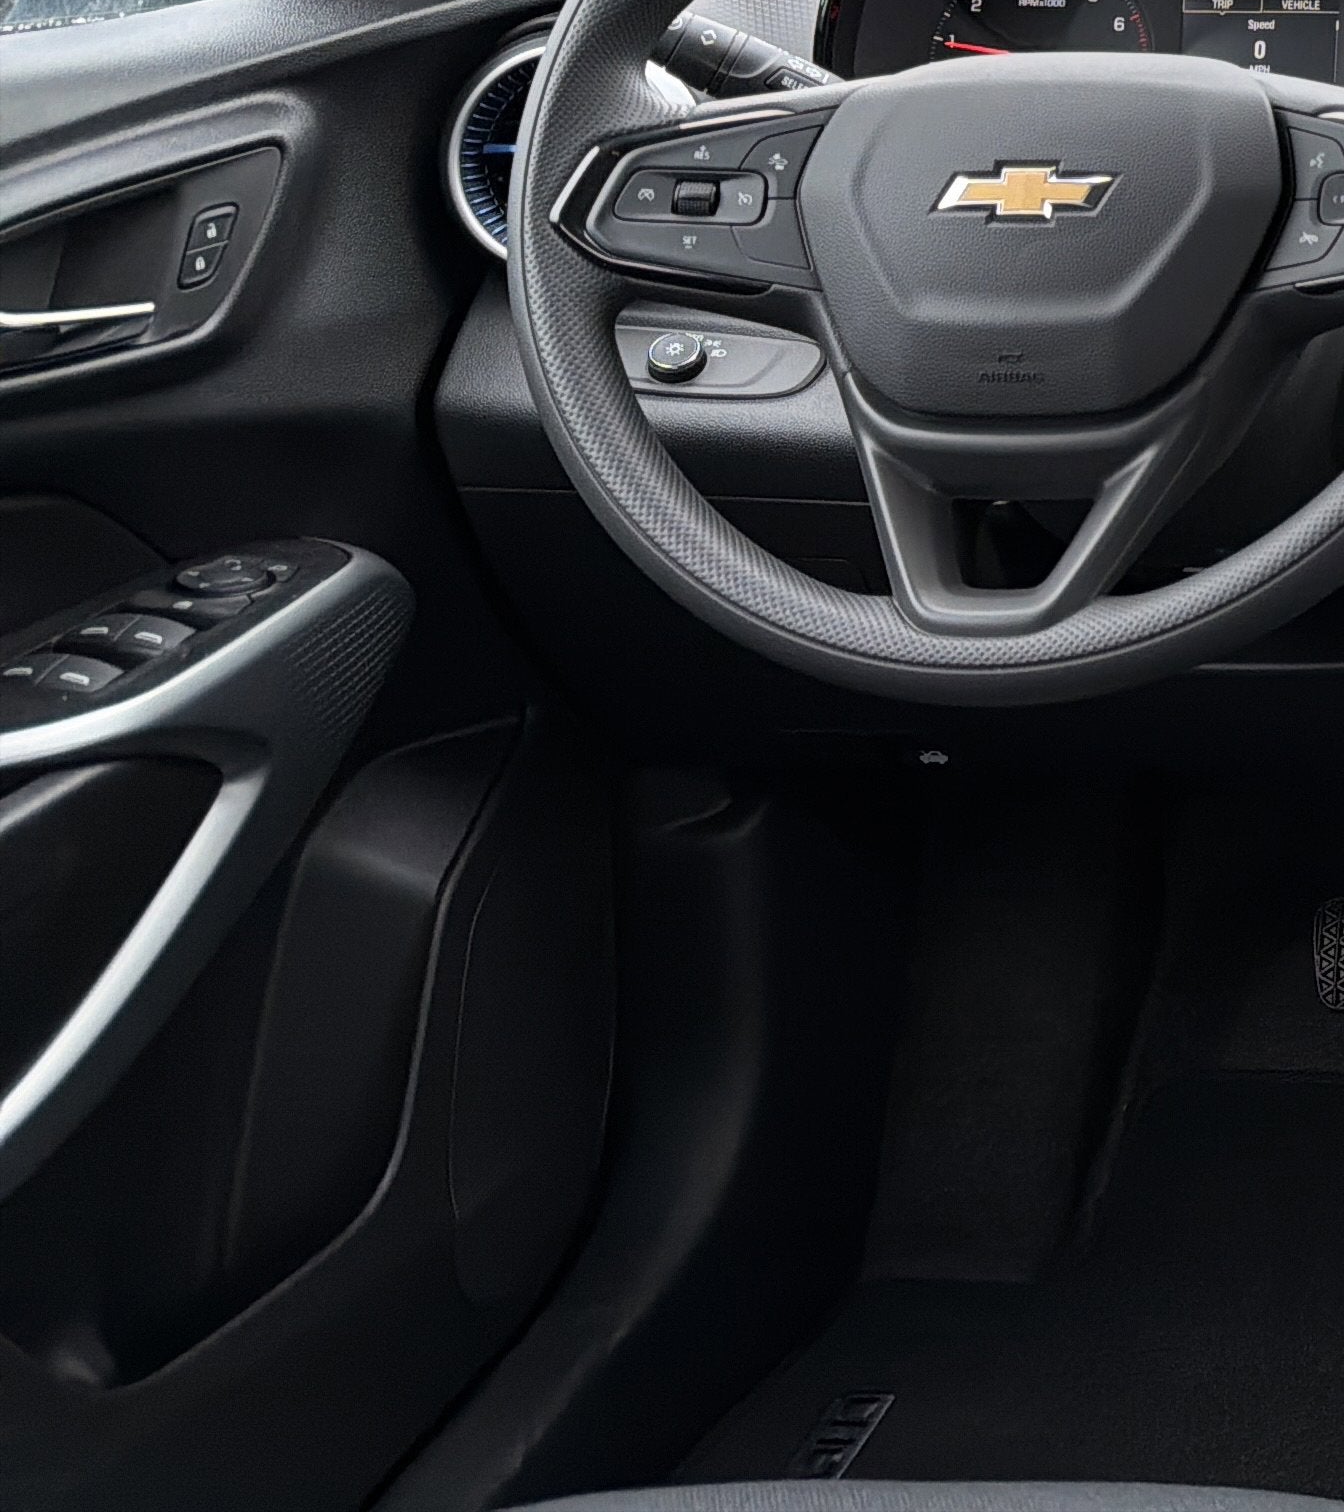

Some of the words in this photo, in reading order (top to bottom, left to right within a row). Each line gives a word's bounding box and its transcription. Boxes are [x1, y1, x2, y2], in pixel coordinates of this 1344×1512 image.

[1112, 16, 1125, 32] 6
[1246, 19, 1276, 32] Speed
[1253, 39, 1267, 61] 0
